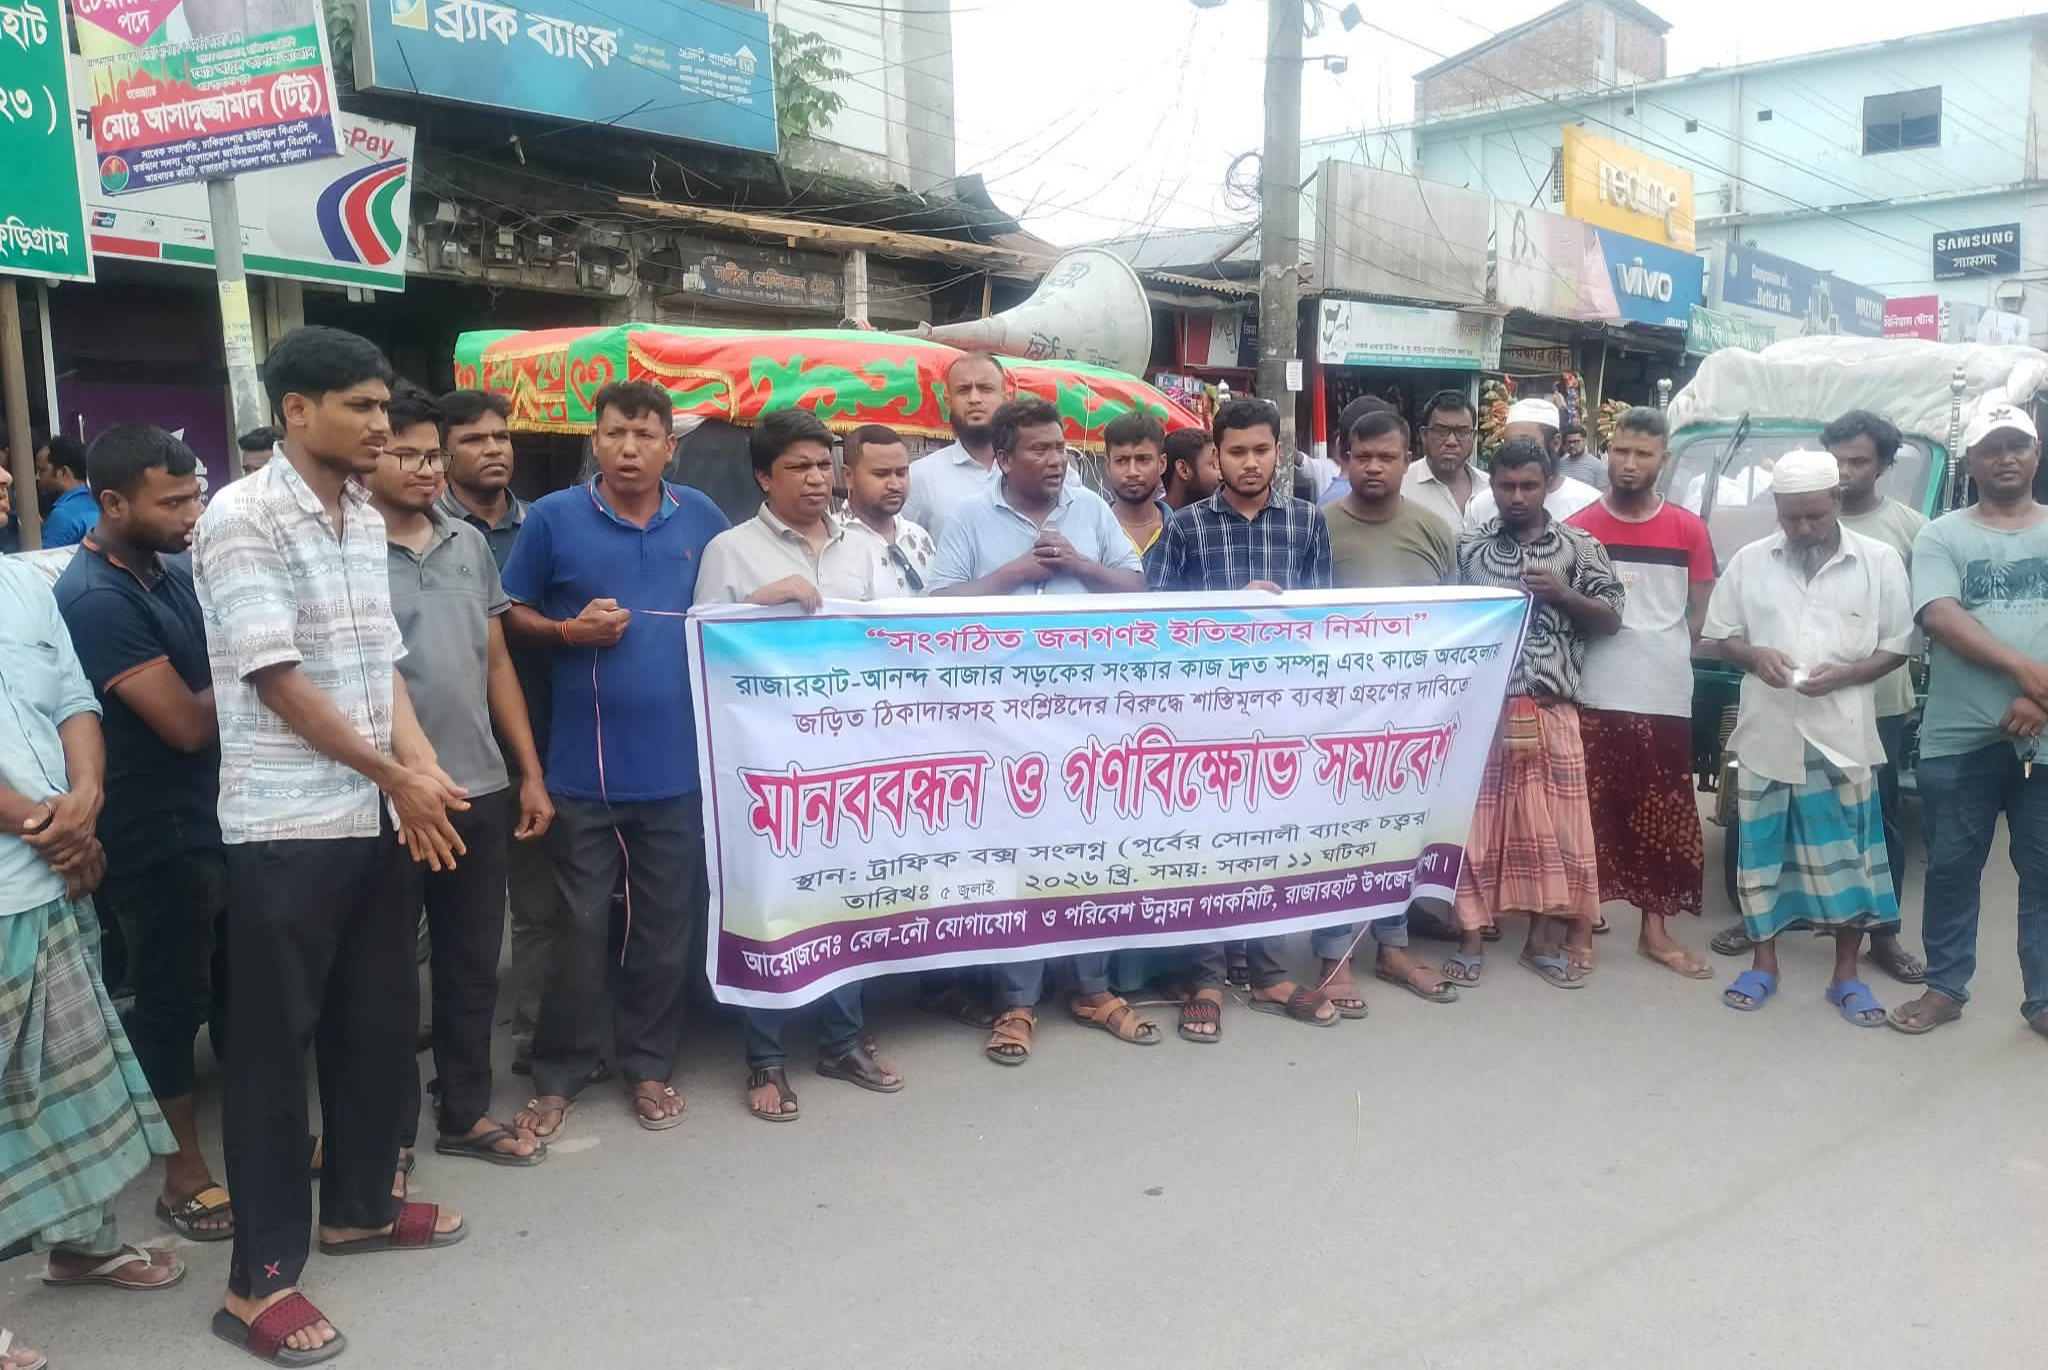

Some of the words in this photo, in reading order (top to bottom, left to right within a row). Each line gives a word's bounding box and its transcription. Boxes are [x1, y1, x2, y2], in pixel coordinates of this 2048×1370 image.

[0, 2, 48, 51] হাট
[118, 10, 150, 35] পদে
[525, 13, 618, 71] ব্যাংক
[102, 111, 140, 142] মোঃ
[142, 88, 265, 132] আসাদুজ্জামান
[270, 72, 322, 118] (টিটু)
[1936, 231, 2014, 251] SAMSUNG
[1952, 253, 1998, 269] স্যামসাং
[1616, 256, 1672, 302] vivo
[1757, 285, 1778, 311] Better
[865, 624, 1023, 654] “সংগঠিত
[1033, 619, 1160, 651] জনগণই
[1167, 617, 1316, 647] ইতিহাসের
[1324, 609, 1429, 641] নির্মাতা”
[730, 664, 931, 699] রাজারহাট-আনন্দ
[935, 663, 1003, 689] বাজার
[1011, 661, 1095, 687] সড়কের
[1101, 657, 1171, 684] সংস্কার
[1177, 656, 1223, 681] কাজ
[1227, 654, 1268, 682] দ্রুত
[1274, 652, 1330, 682] সম্পন্ন
[1336, 652, 1374, 674] এবং
[1380, 650, 1429, 671] কাজে
[1433, 642, 1503, 666] অবহেলায়
[792, 706, 866, 737] জড়িত
[873, 699, 997, 727] ঠিকাদারসহ
[1002, 693, 1108, 720] সংশ্লিষ্টদের
[1114, 690, 1184, 716] বিরুদ্ধে
[1190, 684, 1283, 717] শাস্তিমূলক
[1289, 682, 1345, 707] ব্যবস্থা
[1350, 680, 1412, 705] গ্রহণের
[1416, 673, 1472, 699] দাবিতে
[740, 752, 992, 855] মানববন্ধন
[1003, 754, 1047, 817] ও
[1063, 724, 1309, 822] গণবিক্ষোভ
[1311, 714, 1460, 802] সমাবেশ
[866, 851, 961, 881] ট্রাফিক
[968, 847, 1018, 865] বক্স
[1029, 840, 1107, 863] সংলগ্ন
[1117, 829, 1201, 860] (পূর্বের
[1211, 823, 1301, 850] সোনালী
[1310, 817, 1371, 842] ব্যাংক
[940, 885, 951, 900] ৫
[957, 879, 996, 900] জুলাই
[1024, 870, 1099, 892] ২০২৬
[1106, 863, 1139, 887] খ্রি.
[1217, 854, 1280, 875] সকাল
[1286, 849, 1312, 869] ১১
[1320, 841, 1378, 862] ঘটিকা
[742, 935, 842, 979] আয়োজনেঃ
[849, 917, 930, 953] রেল-নৌ
[935, 908, 1028, 940] যোগাযোগ
[1041, 908, 1058, 928] ও
[1064, 900, 1134, 928] পরিবেশ
[1141, 894, 1194, 926] উন্নয়ন
[1199, 883, 1278, 919] গণকমিটি,
[1285, 873, 1356, 905] রাজারহাট
